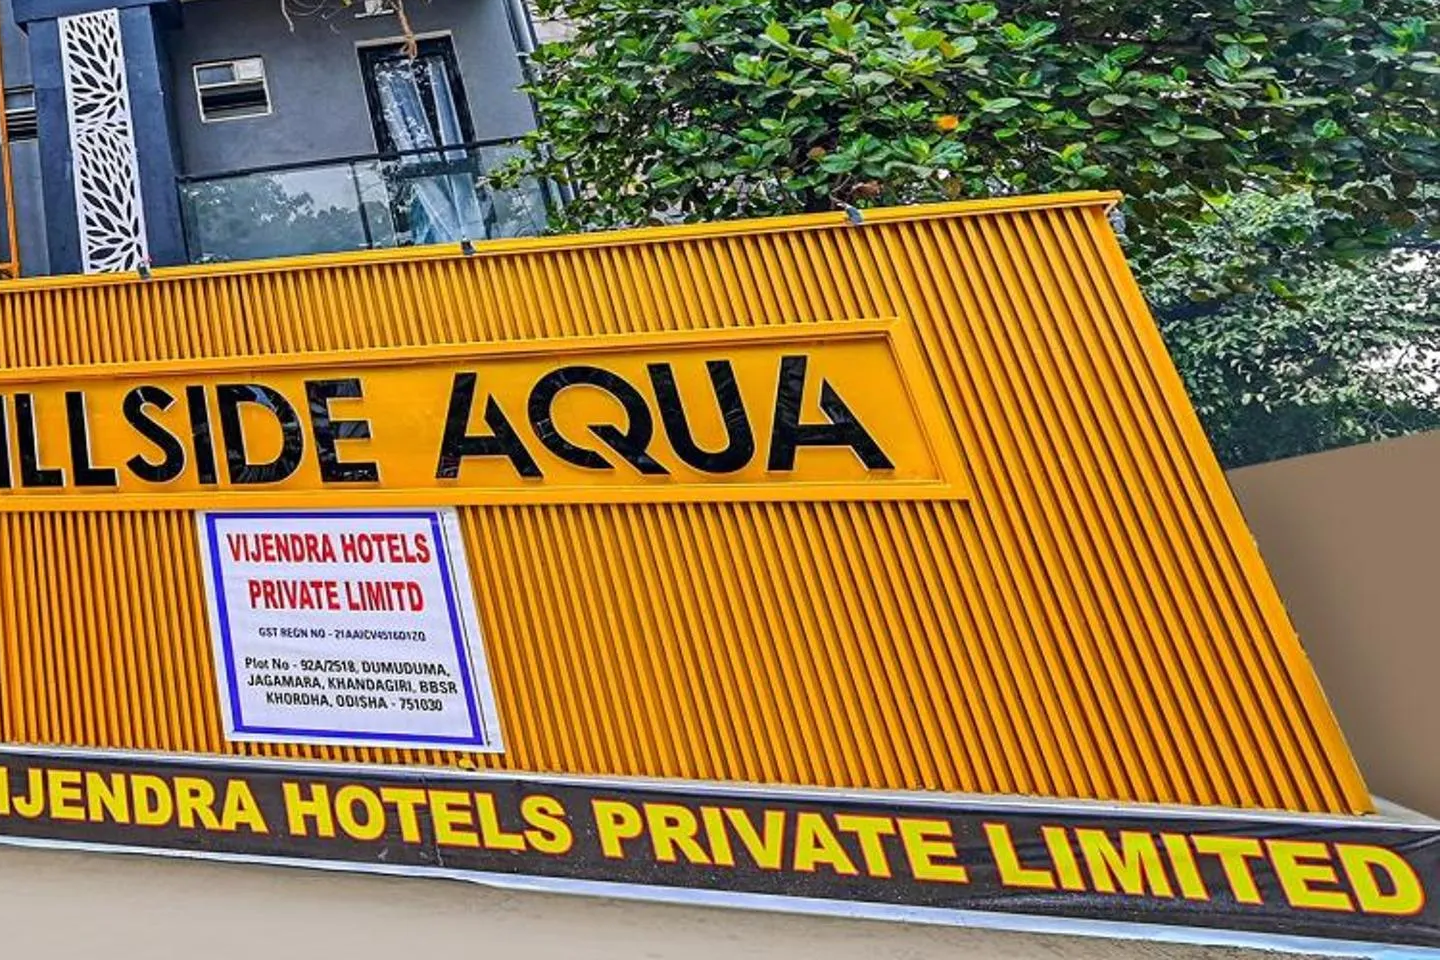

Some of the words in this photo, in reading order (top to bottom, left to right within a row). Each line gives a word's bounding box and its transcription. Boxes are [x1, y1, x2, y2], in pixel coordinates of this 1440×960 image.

[435, 354, 897, 480] AQUA
[227, 533, 337, 563] VIJENDRA
[340, 534, 431, 565] HOTELS
[248, 579, 341, 611] PRIVATE
[345, 580, 425, 612] LIMITD
[258, 627, 278, 638] GST
[280, 627, 309, 639] REGN
[310, 628, 326, 639] NO
[245, 656, 270, 670] Plot
[272, 658, 290, 671] No
[361, 661, 451, 677] DUMUDUMA,
[247, 674, 326, 690] JAGAMARA,
[327, 677, 417, 694] KHANDAGIRI,
[419, 681, 458, 695] BBSR
[266, 692, 333, 708] KHORDHA,
[335, 695, 389, 709] ODISHA
[400, 698, 444, 712] 751030
[280, 780, 574, 855] HOTELS
[589, 797, 970, 885] PRIVATE
[981, 820, 1426, 917] LIMITED
